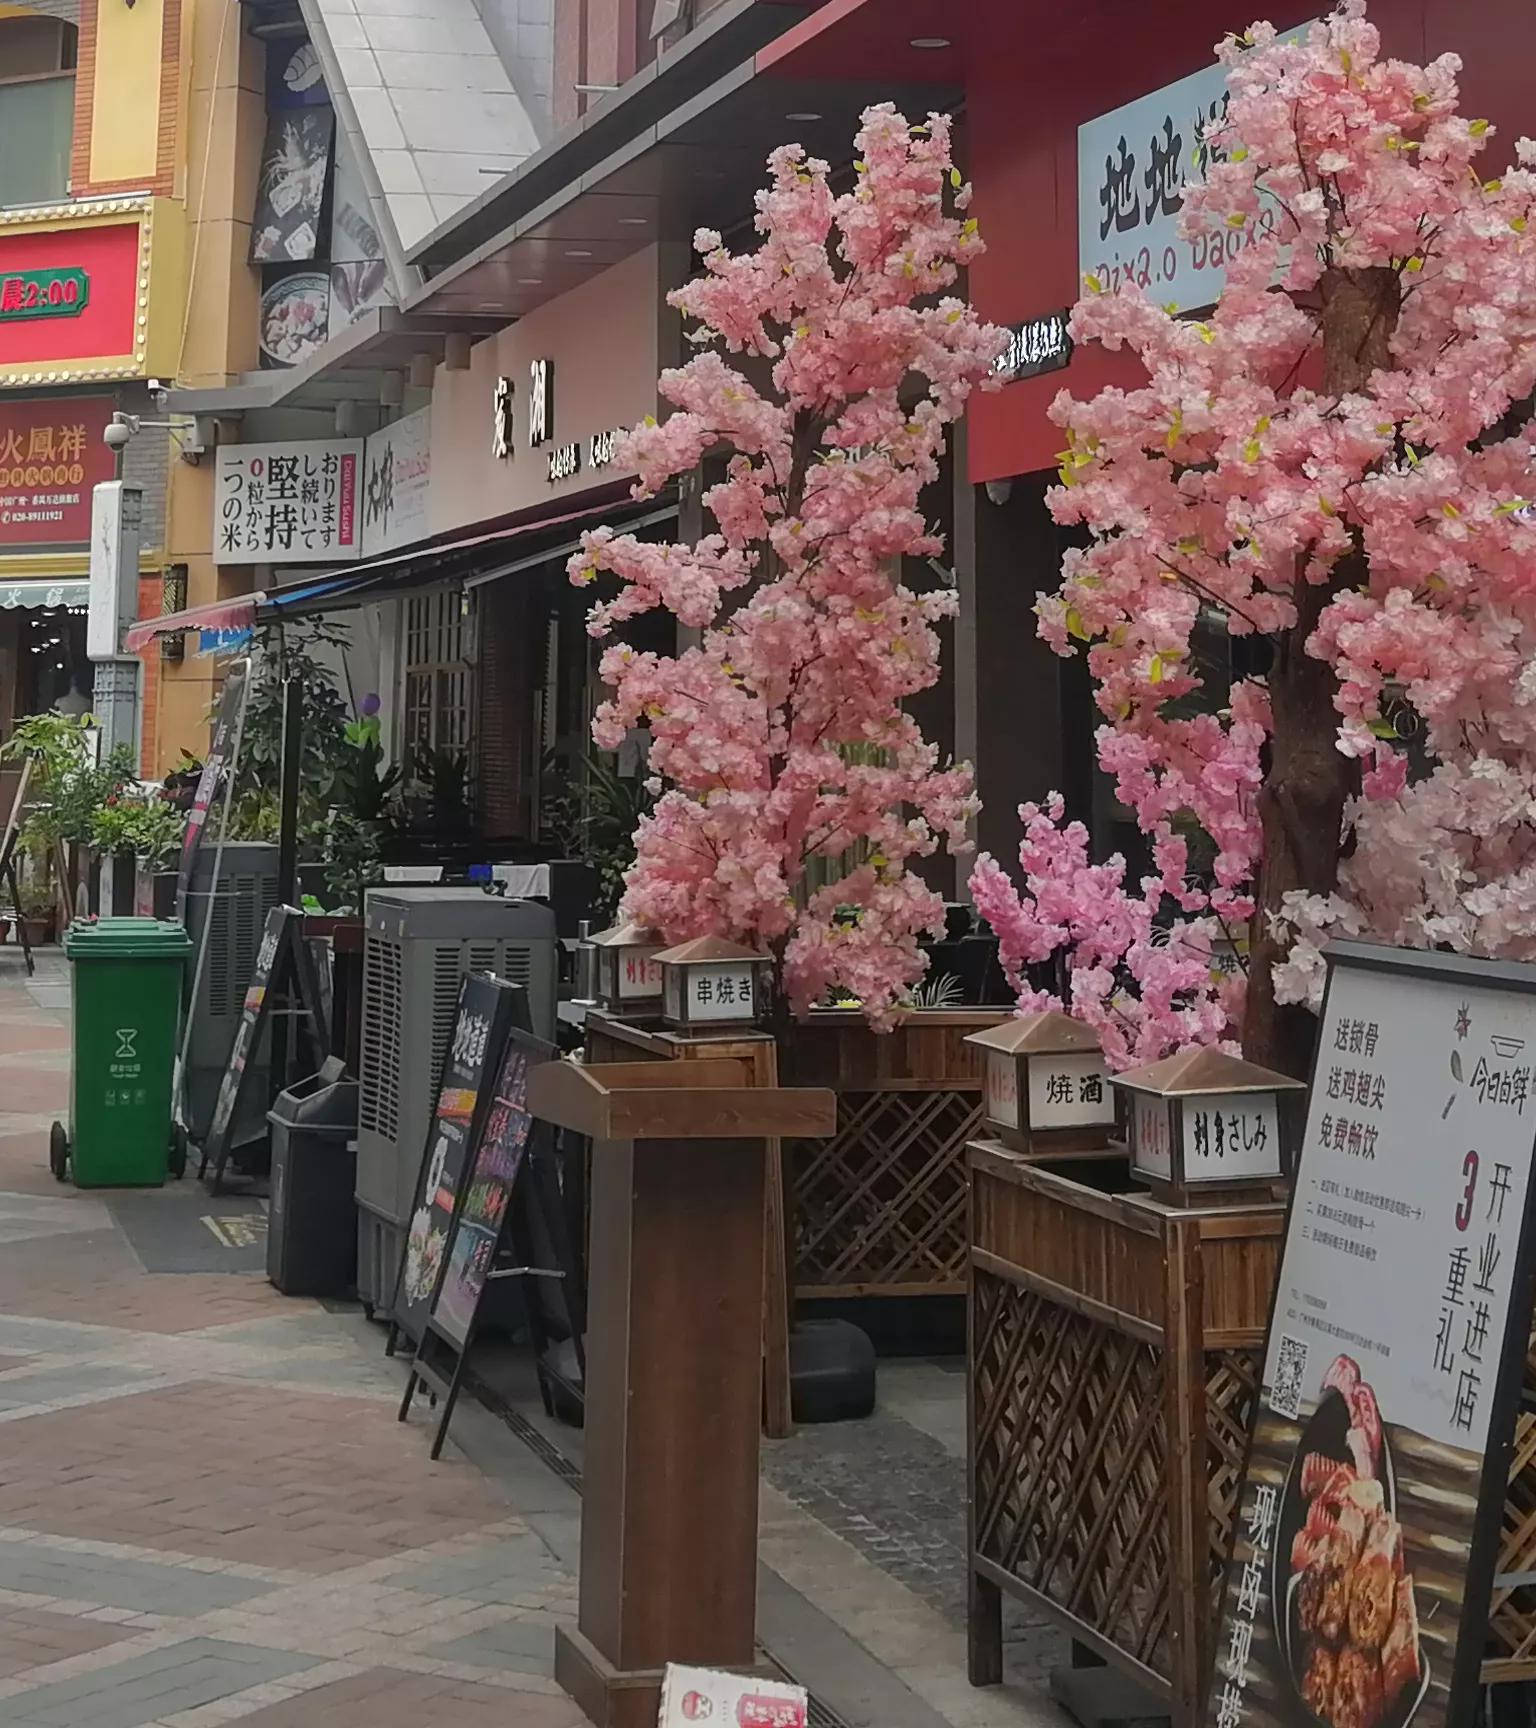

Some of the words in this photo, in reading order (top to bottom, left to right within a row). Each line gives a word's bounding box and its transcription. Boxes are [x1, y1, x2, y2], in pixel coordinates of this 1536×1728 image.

[320, 451, 339, 548] おります
[1333, 1017, 1379, 1059] 送锁骨
[1317, 1112, 1380, 1161] 免费畅饮
[1448, 1162, 1514, 1432] 开业进店
